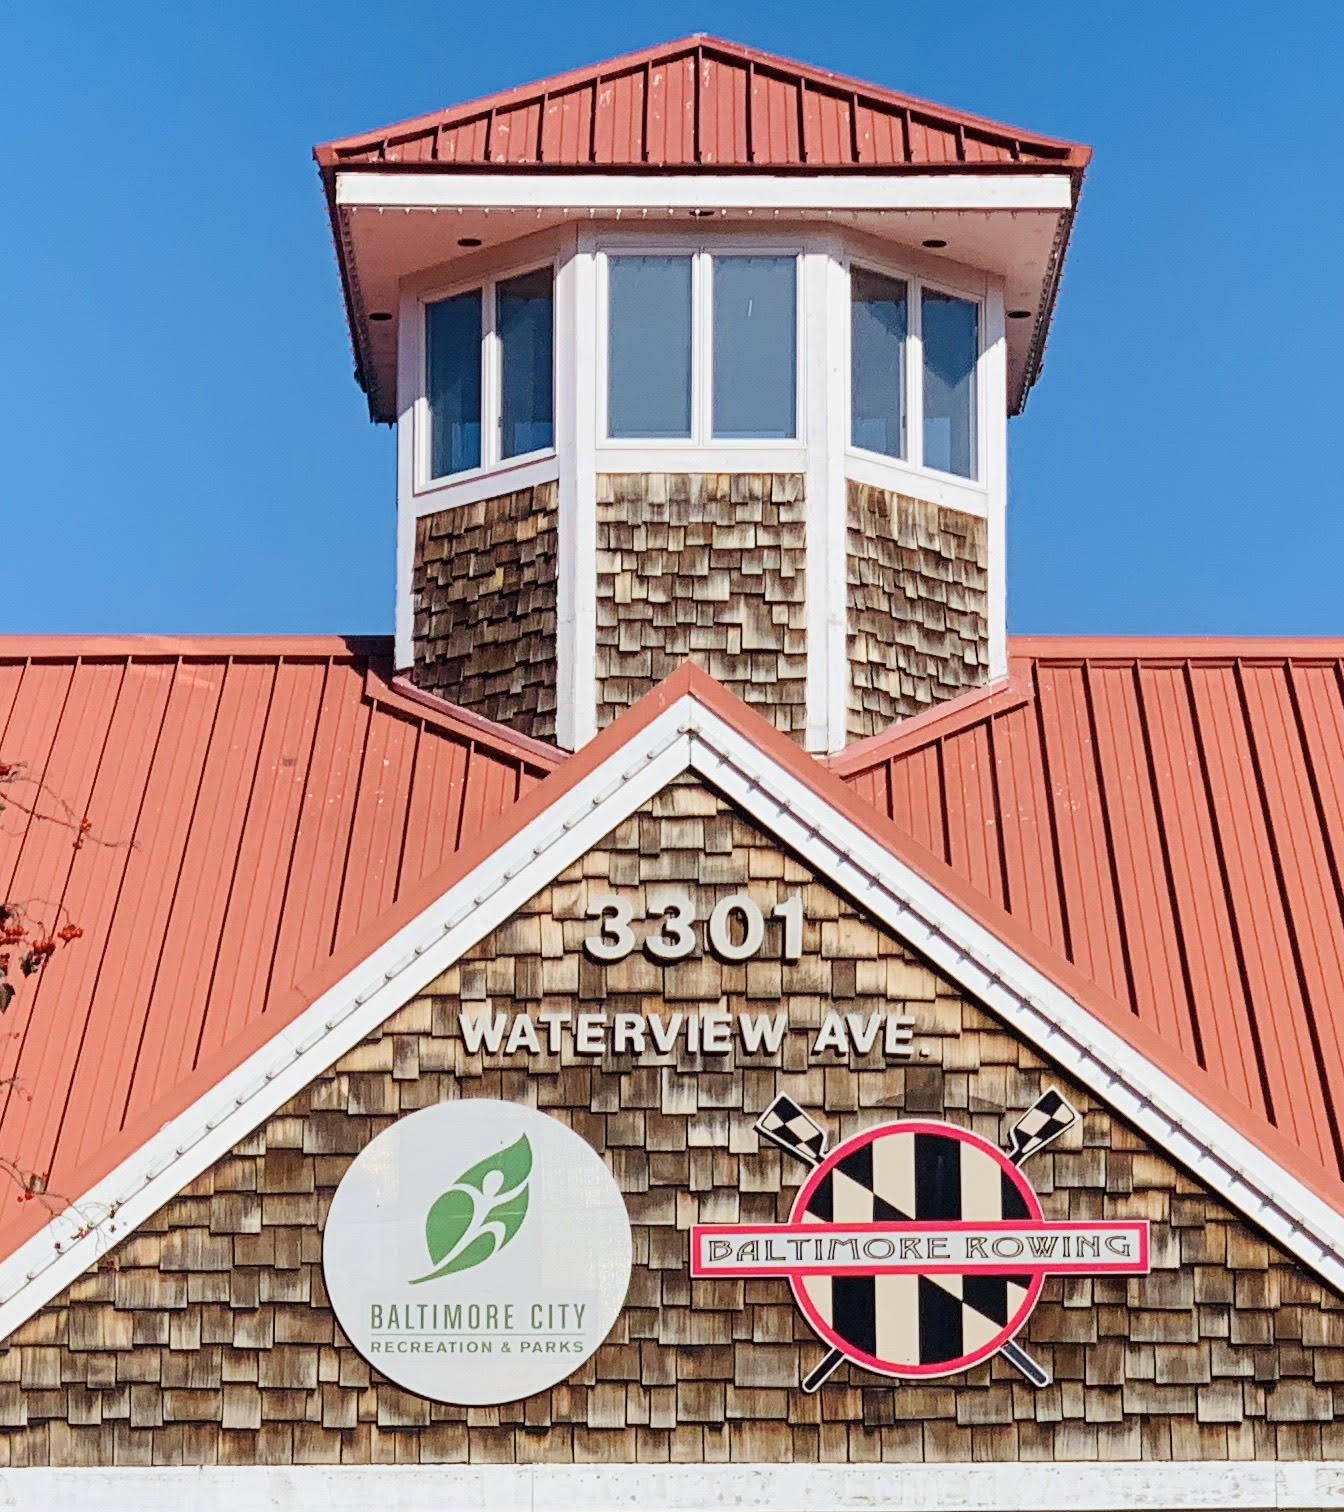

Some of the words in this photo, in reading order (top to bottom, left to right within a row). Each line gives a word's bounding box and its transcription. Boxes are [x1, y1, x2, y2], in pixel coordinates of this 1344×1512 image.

[584, 894, 805, 961] 3301
[459, 1013, 787, 1054] WATERVIEW
[813, 1014, 930, 1056] AVE.
[708, 1235, 951, 1262] BALTIMORE
[965, 1234, 1132, 1260] ROWING
[370, 1303, 515, 1330] BALTIMORE
[530, 1303, 586, 1330] CITY
[370, 1341, 492, 1353] RECREATION
[500, 1341, 512, 1353] &
[520, 1340, 584, 1353] PARKS
